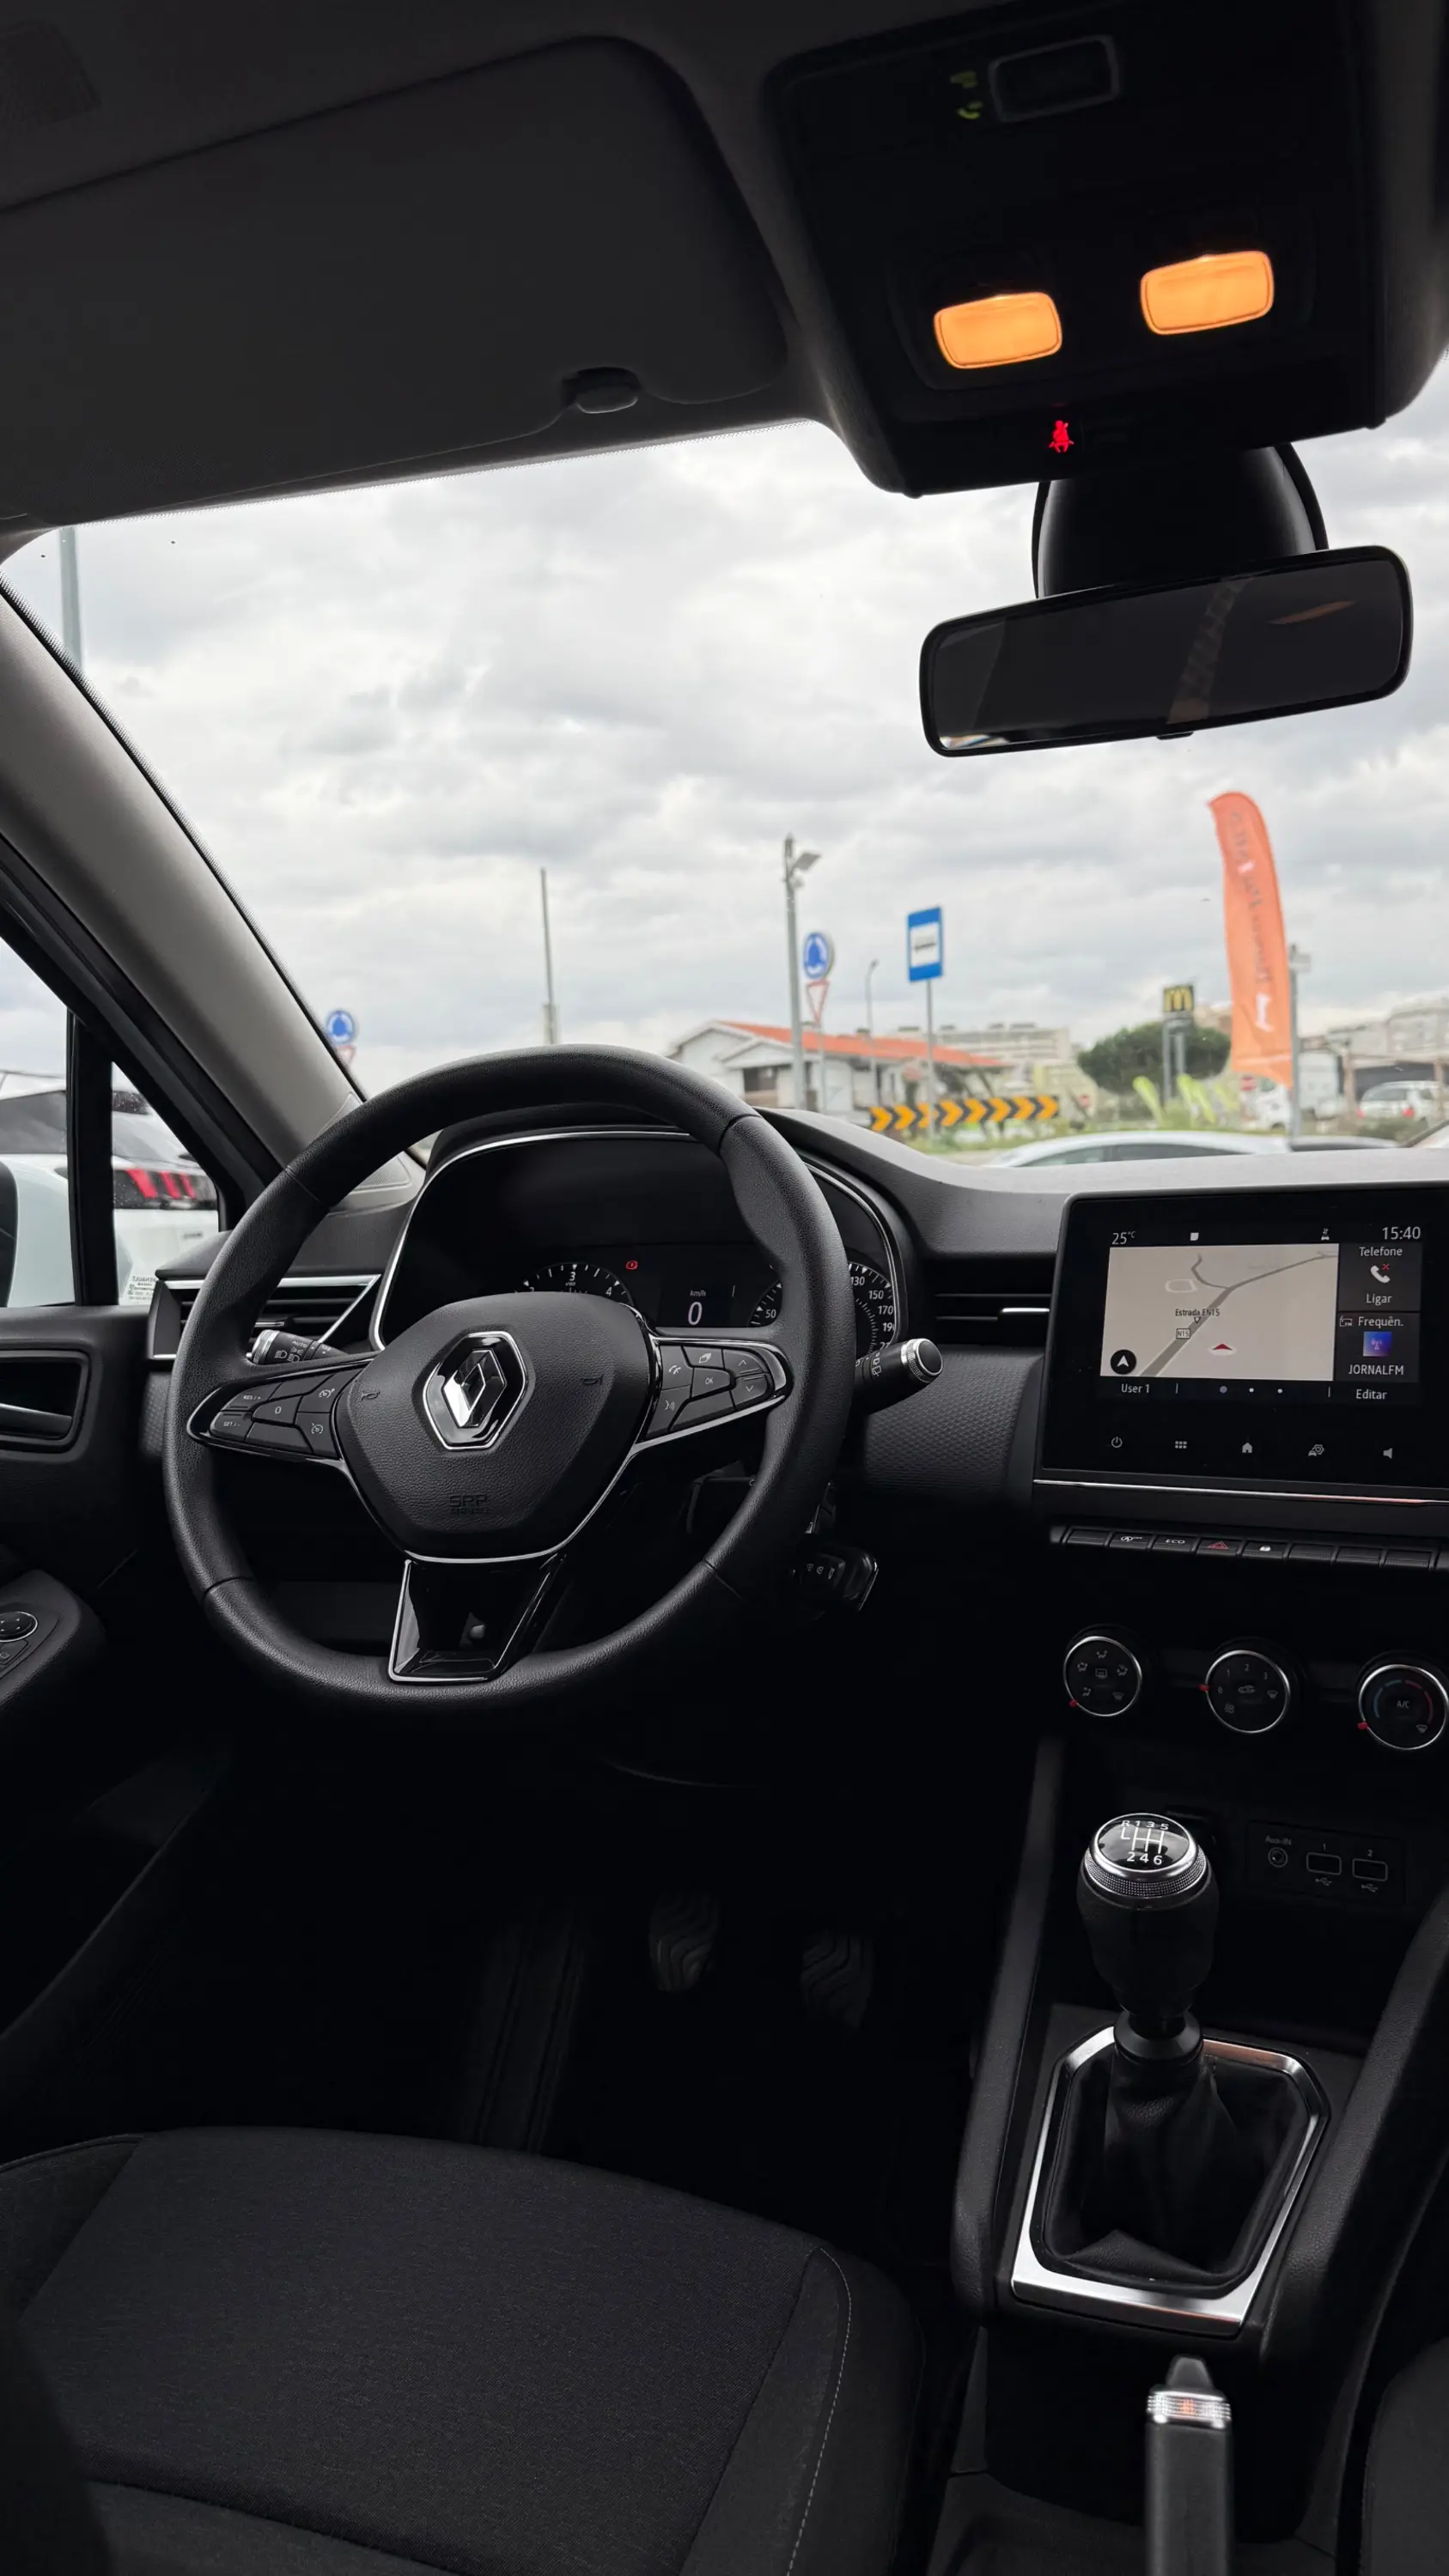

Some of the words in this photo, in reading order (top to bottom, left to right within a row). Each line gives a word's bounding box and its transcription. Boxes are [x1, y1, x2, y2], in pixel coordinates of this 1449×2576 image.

[1382, 1226, 1421, 1240] 15:40
[1359, 1246, 1403, 1256] Telefone
[569, 1272, 576, 1281] 3
[606, 1286, 612, 1296] 4
[868, 1290, 885, 1300] 150
[1366, 1293, 1392, 1306] Ligar
[688, 1301, 703, 1326] 0
[765, 1309, 776, 1319] 50
[878, 1305, 894, 1315] 170
[1175, 1308, 1201, 1317] Estrada
[1202, 1308, 1221, 1317] EN15
[1358, 1315, 1403, 1329] Frequên.
[1348, 1364, 1404, 1376] JORNALFM
[1121, 1383, 1143, 1393] User
[1145, 1383, 1150, 1394] 1
[1355, 1388, 1388, 1400] Editar
[1396, 1700, 1409, 1710] A/C
[1126, 1851, 1135, 1862] 2
[1139, 1852, 1149, 1863] 4
[1153, 1855, 1163, 1865] 6
